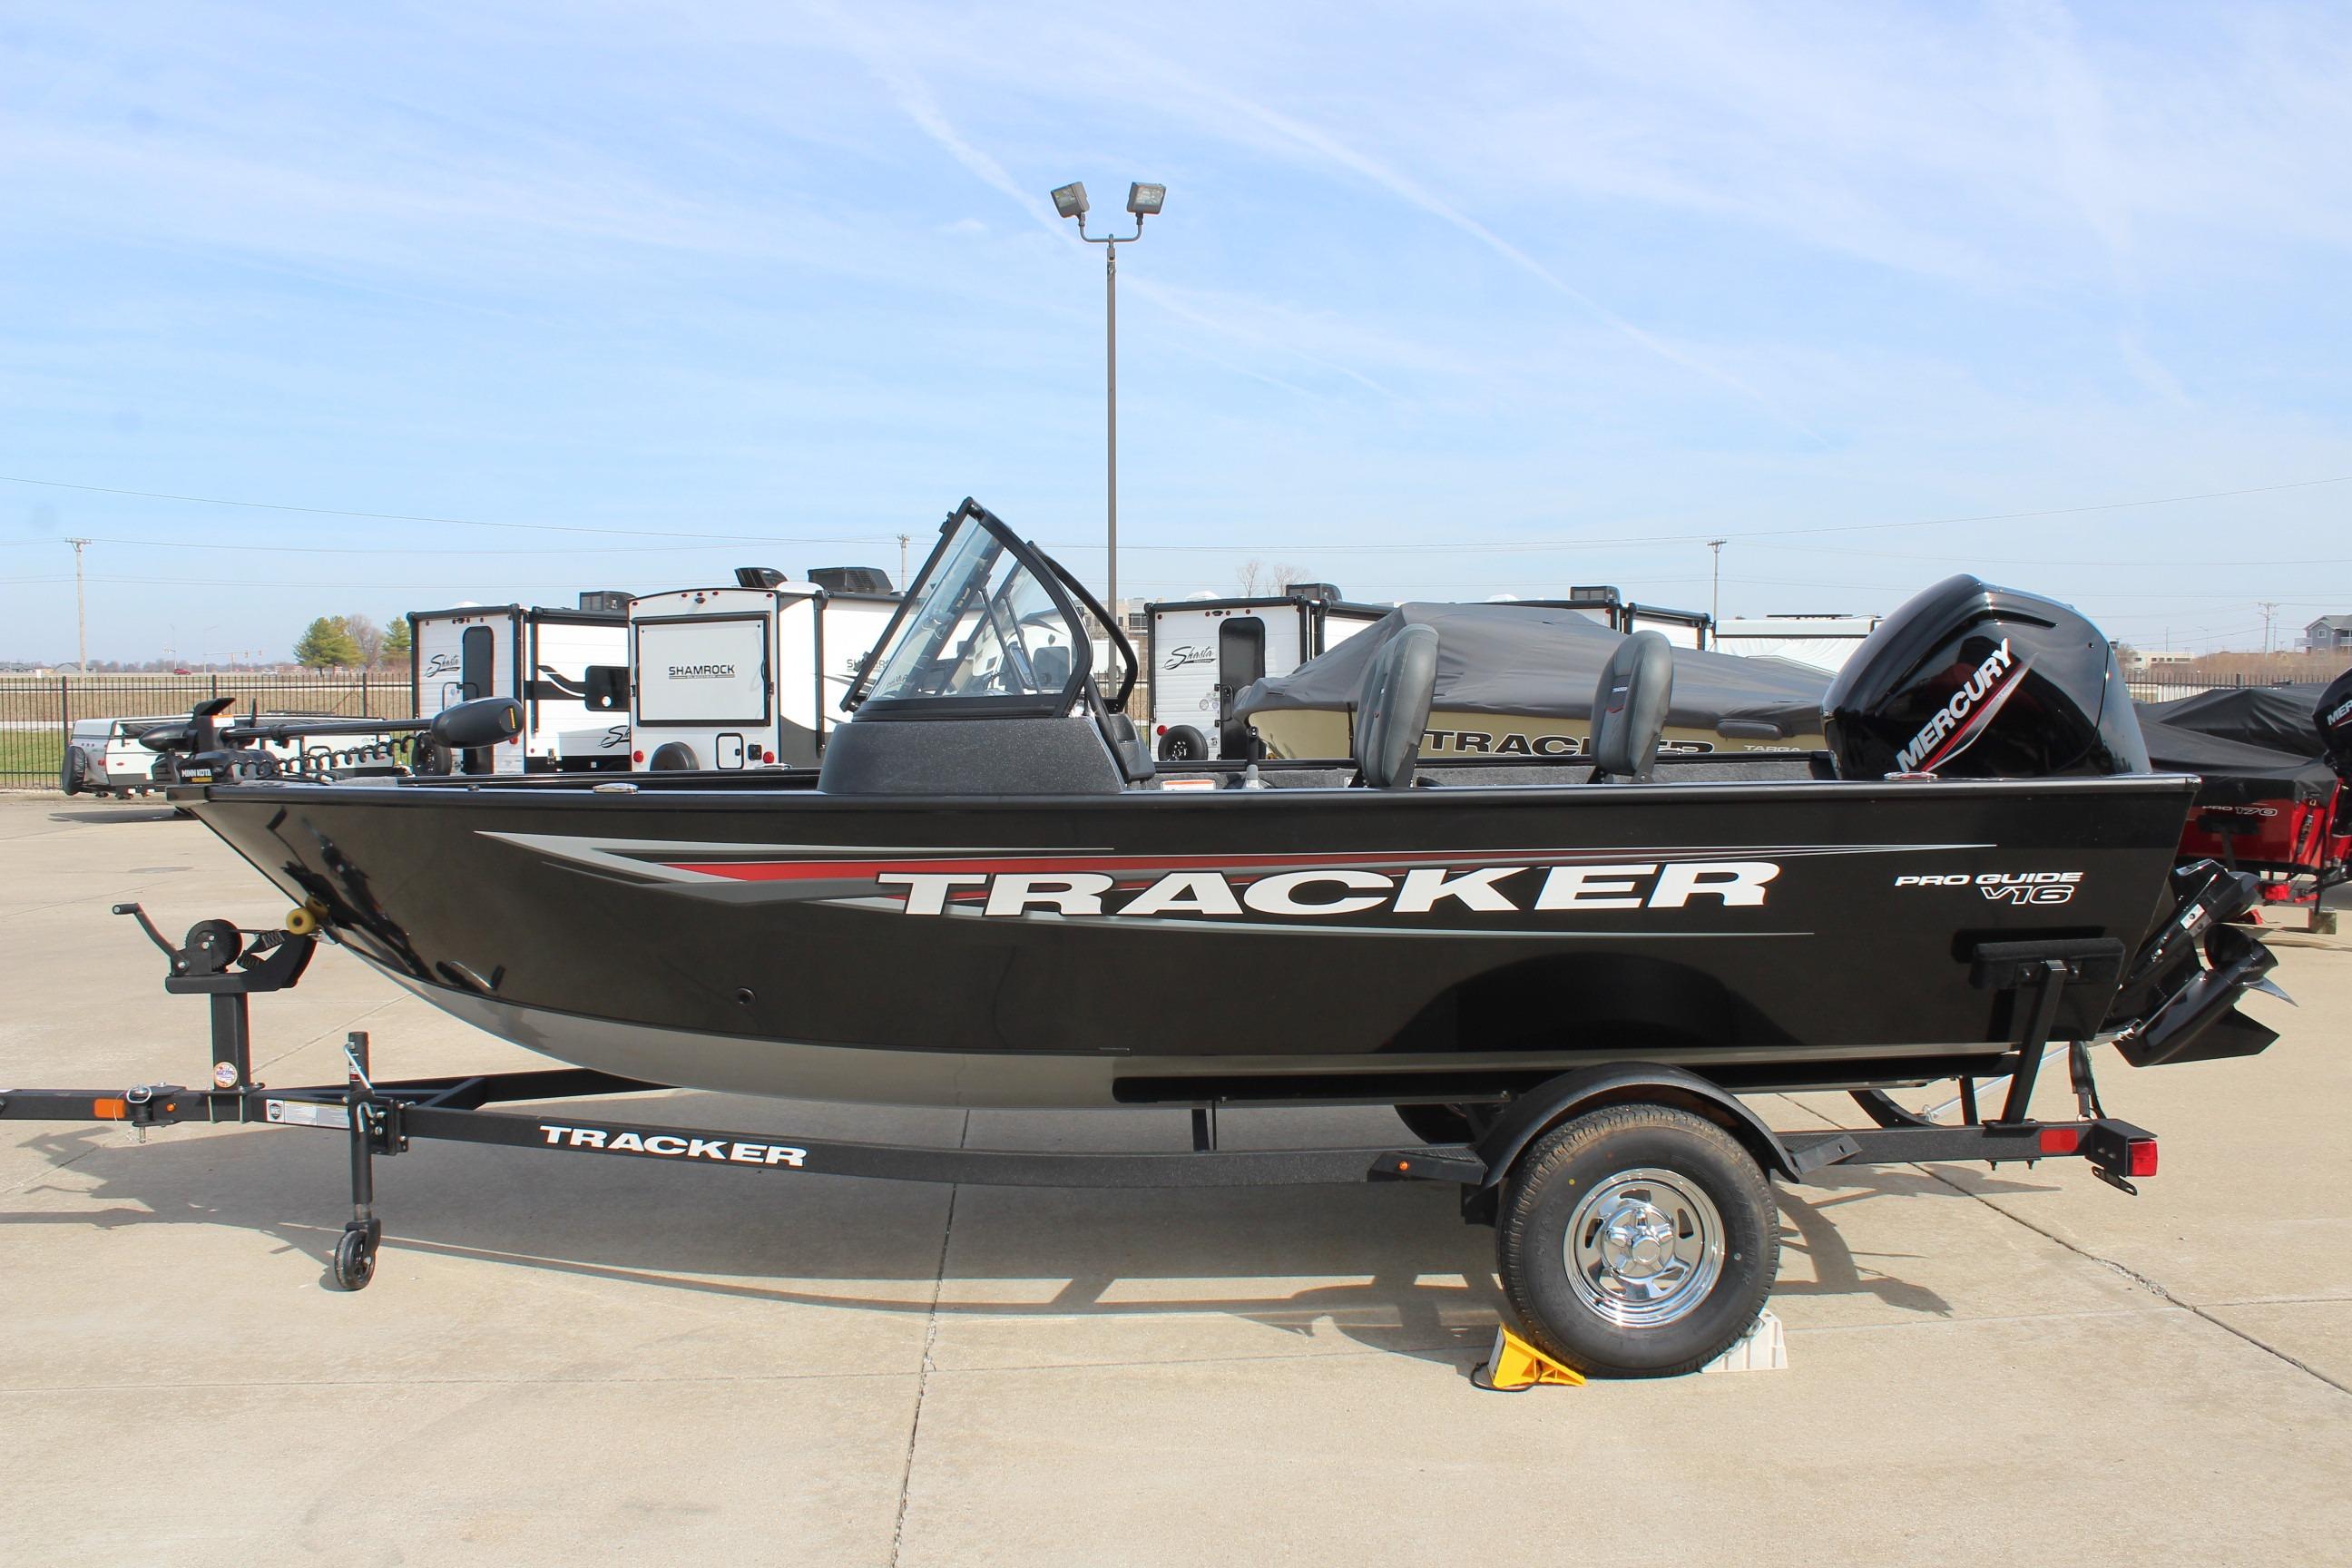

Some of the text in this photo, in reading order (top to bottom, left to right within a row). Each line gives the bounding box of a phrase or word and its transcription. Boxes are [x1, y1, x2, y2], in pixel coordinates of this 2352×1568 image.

[424, 653, 461, 678] Shasta
[669, 664, 735, 676] SHAMROCK
[1162, 646, 1215, 670] Shasta
[1896, 638, 2012, 772] MERCURY
[181, 768, 211, 778] MINN KOTA
[877, 861, 1780, 916] TRACKER
[1895, 872, 2083, 887] PRO GUIDE
[1980, 885, 2074, 905] V16
[539, 1124, 807, 1167] TRACKER
